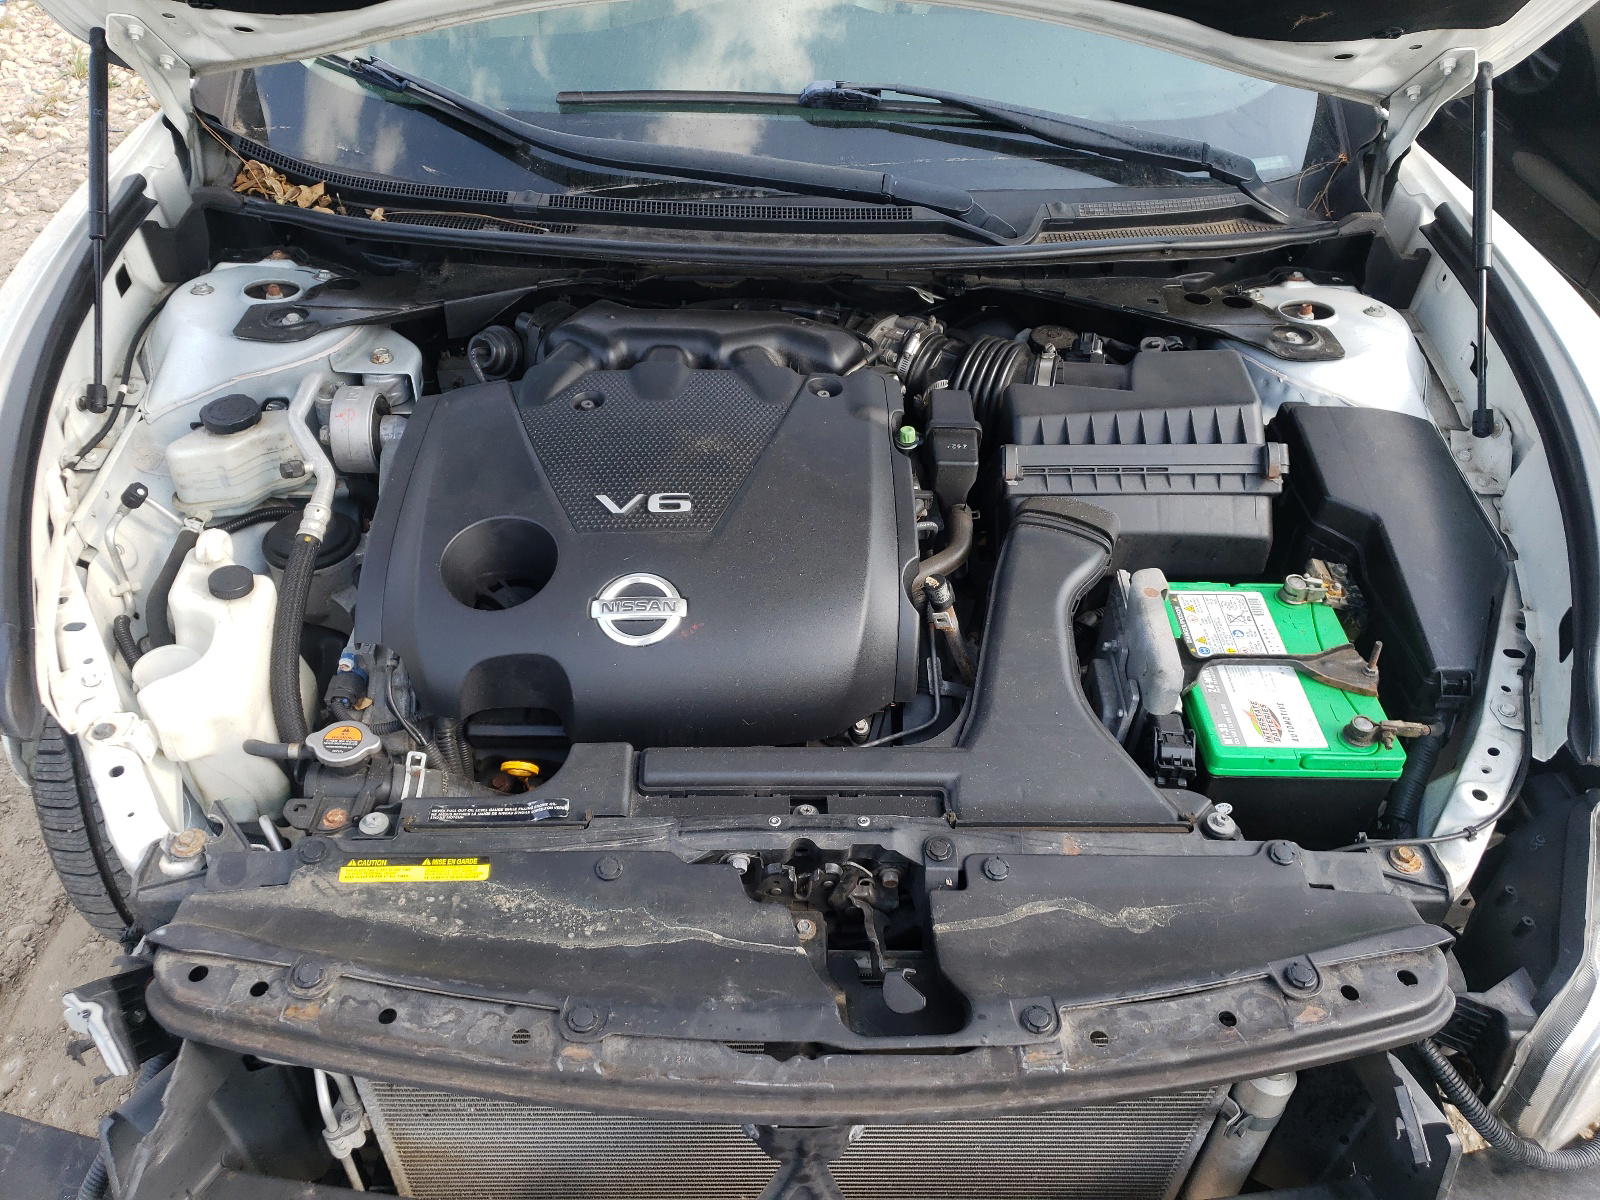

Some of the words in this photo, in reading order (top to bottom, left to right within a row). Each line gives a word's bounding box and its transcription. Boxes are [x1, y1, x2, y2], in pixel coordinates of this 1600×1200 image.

[595, 492, 692, 514] V6
[601, 600, 677, 613] NISSAN
[1250, 700, 1272, 743] INTERSTATE
[1260, 703, 1281, 742] BATTERIES
[1276, 701, 1300, 743] AUTOMOTIVE
[357, 859, 388, 867] CAUTION
